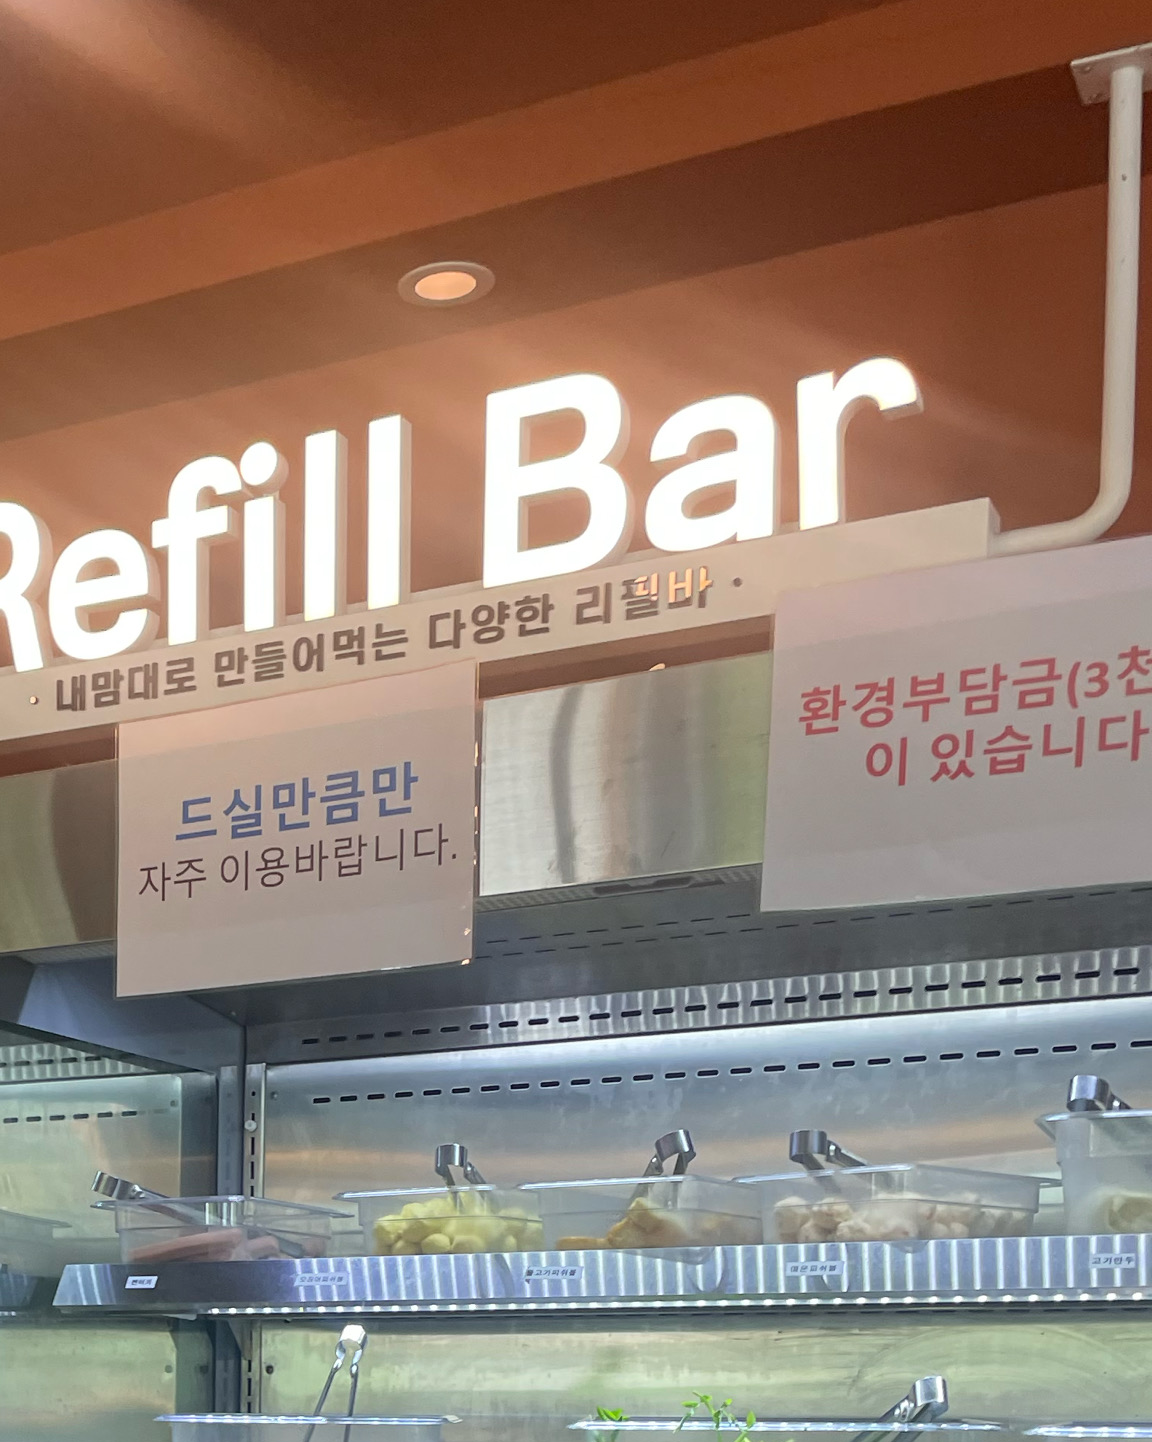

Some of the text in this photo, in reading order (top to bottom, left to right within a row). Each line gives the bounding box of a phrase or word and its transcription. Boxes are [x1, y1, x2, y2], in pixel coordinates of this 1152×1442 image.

[482, 357, 924, 592] Bar
[55, 565, 714, 713] 내맘대로 만들어먹는 다양한 리필바
[864, 708, 1151, 787] 이 있습니다
[174, 760, 420, 841] 드실만큼만
[138, 822, 458, 902] 자주 이용바랍니다.
